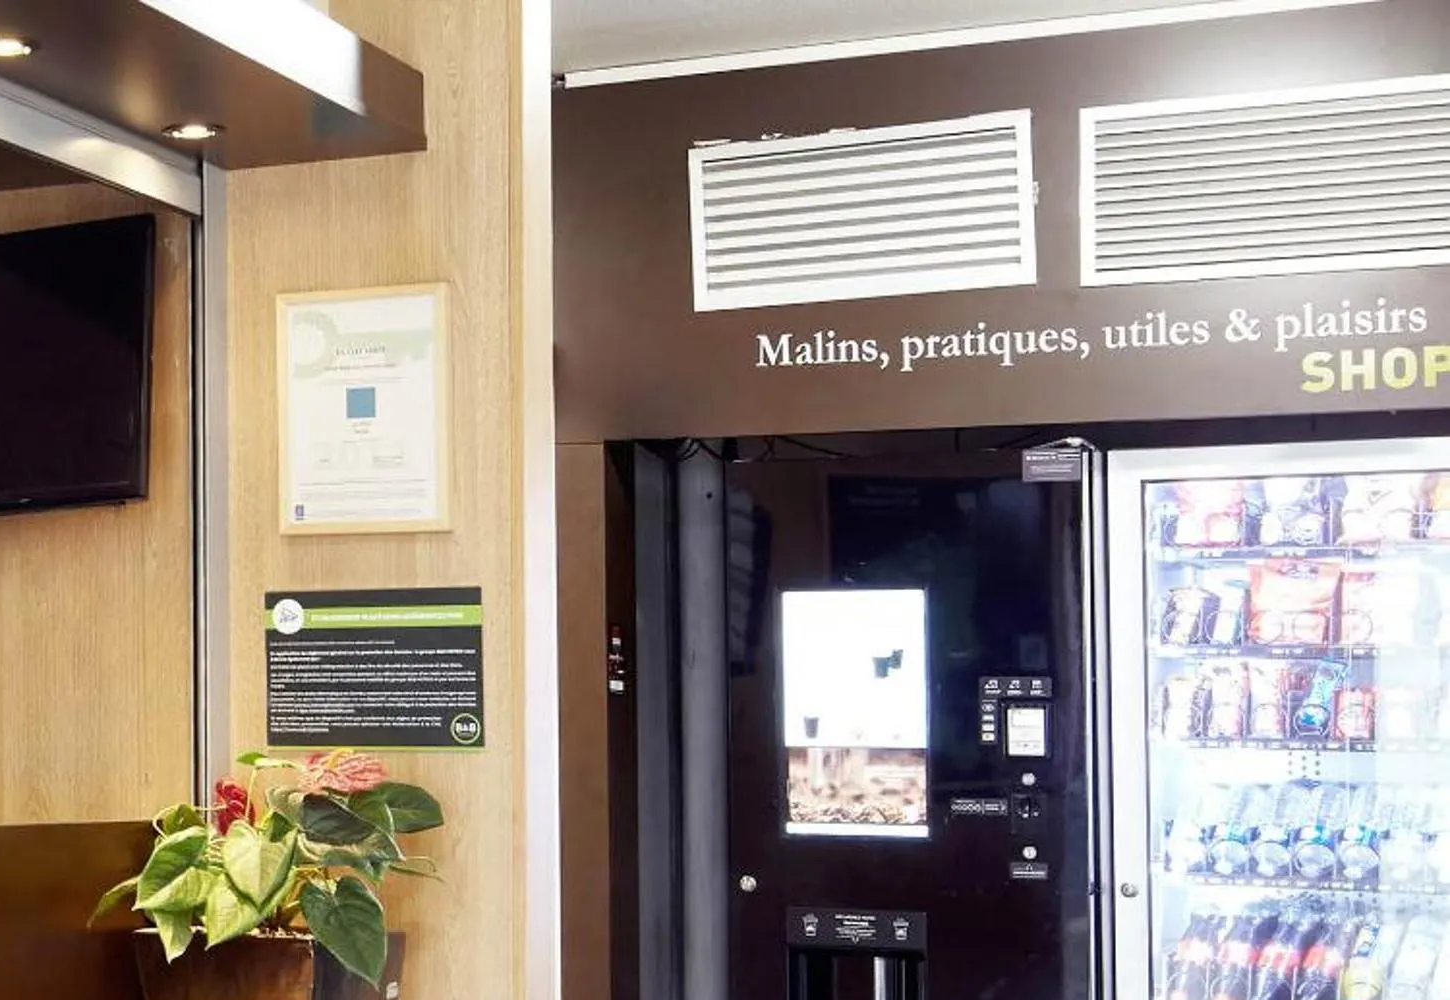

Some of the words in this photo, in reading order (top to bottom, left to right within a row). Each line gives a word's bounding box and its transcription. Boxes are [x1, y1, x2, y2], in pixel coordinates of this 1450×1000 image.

[755, 330, 890, 370] Malins,
[900, 322, 1091, 372] pratiques,
[1102, 311, 1211, 349] utiles
[1224, 308, 1262, 342] &
[1273, 297, 1428, 353] plaisirs
[1301, 344, 1450, 393] SHOP
